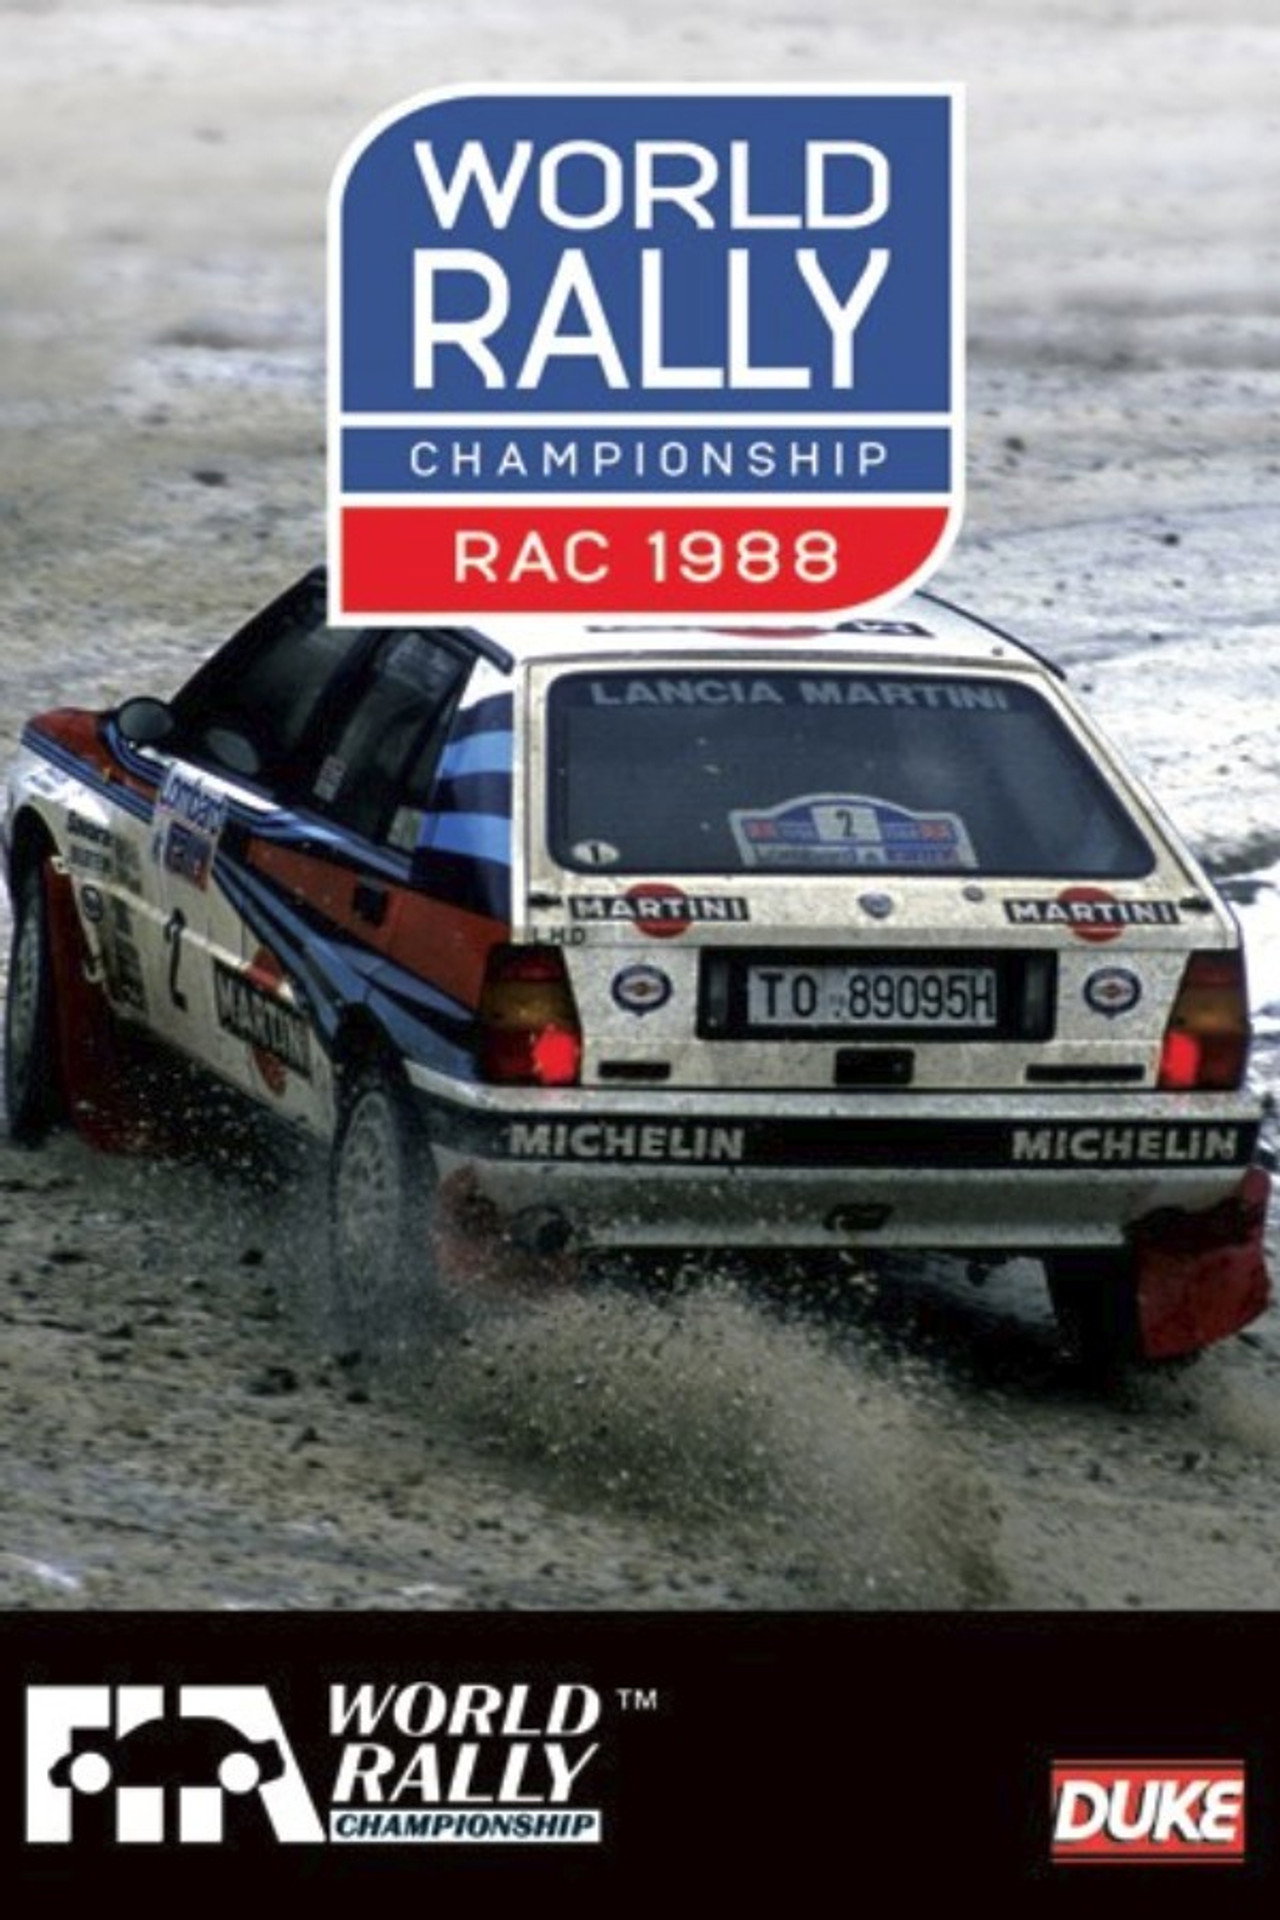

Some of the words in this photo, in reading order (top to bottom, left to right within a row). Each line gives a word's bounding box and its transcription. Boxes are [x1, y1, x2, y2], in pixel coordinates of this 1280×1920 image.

[591, 680, 784, 705] LANCIA
[799, 682, 1009, 709] MARTINI
[836, 809, 857, 837] 2
[571, 897, 744, 918] MARTINI
[1011, 902, 1173, 923] MARTINI
[758, 973, 817, 1018] TO
[849, 975, 994, 1019] 89095H
[508, 1124, 745, 1159] MICHELIN
[1011, 1129, 1239, 1162] MICHELIN
